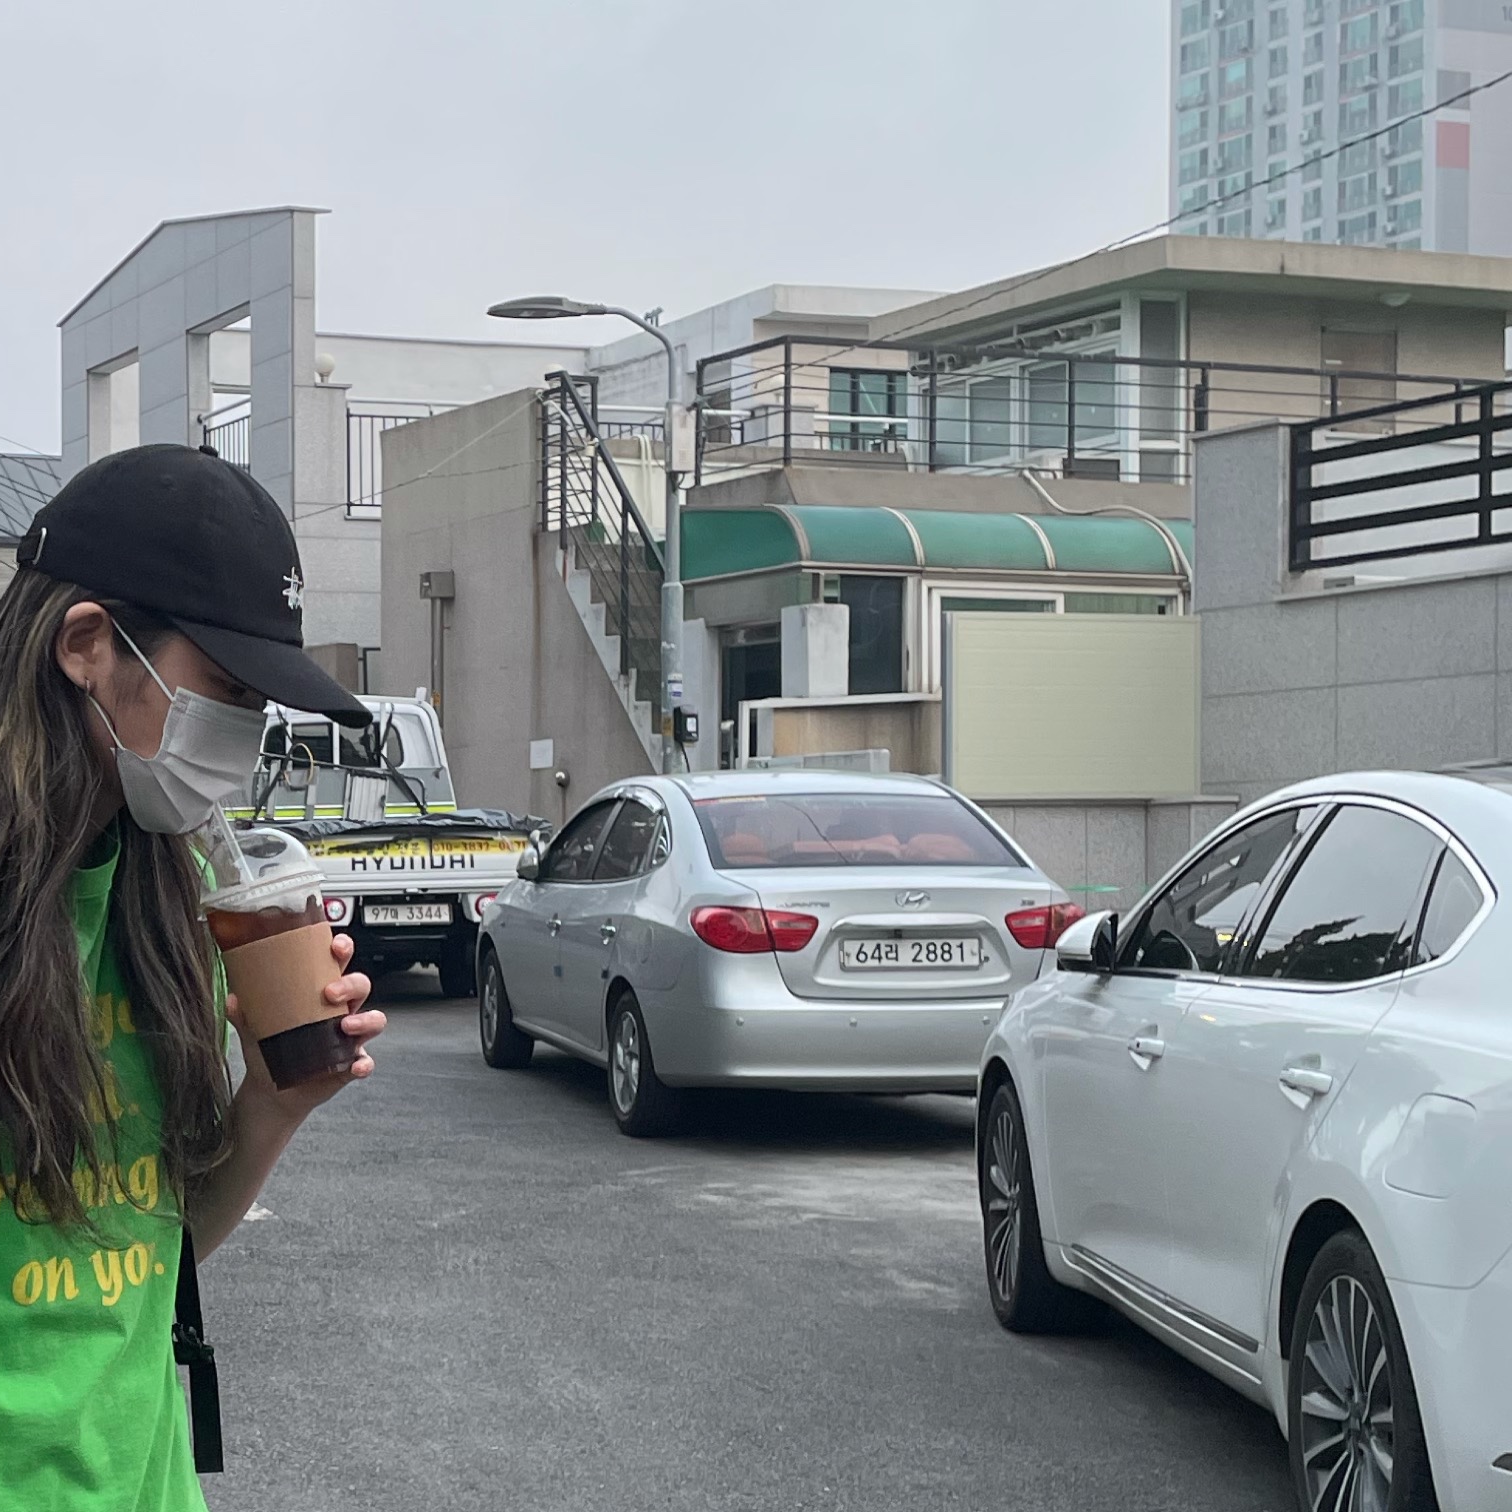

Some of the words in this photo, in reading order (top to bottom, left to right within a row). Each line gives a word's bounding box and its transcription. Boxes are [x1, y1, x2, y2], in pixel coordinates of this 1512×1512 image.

[351, 853, 475, 871] HYUNDAI
[406, 905, 442, 920] 3344
[911, 941, 965, 963] 2881
[12, 1256, 80, 1305] on
